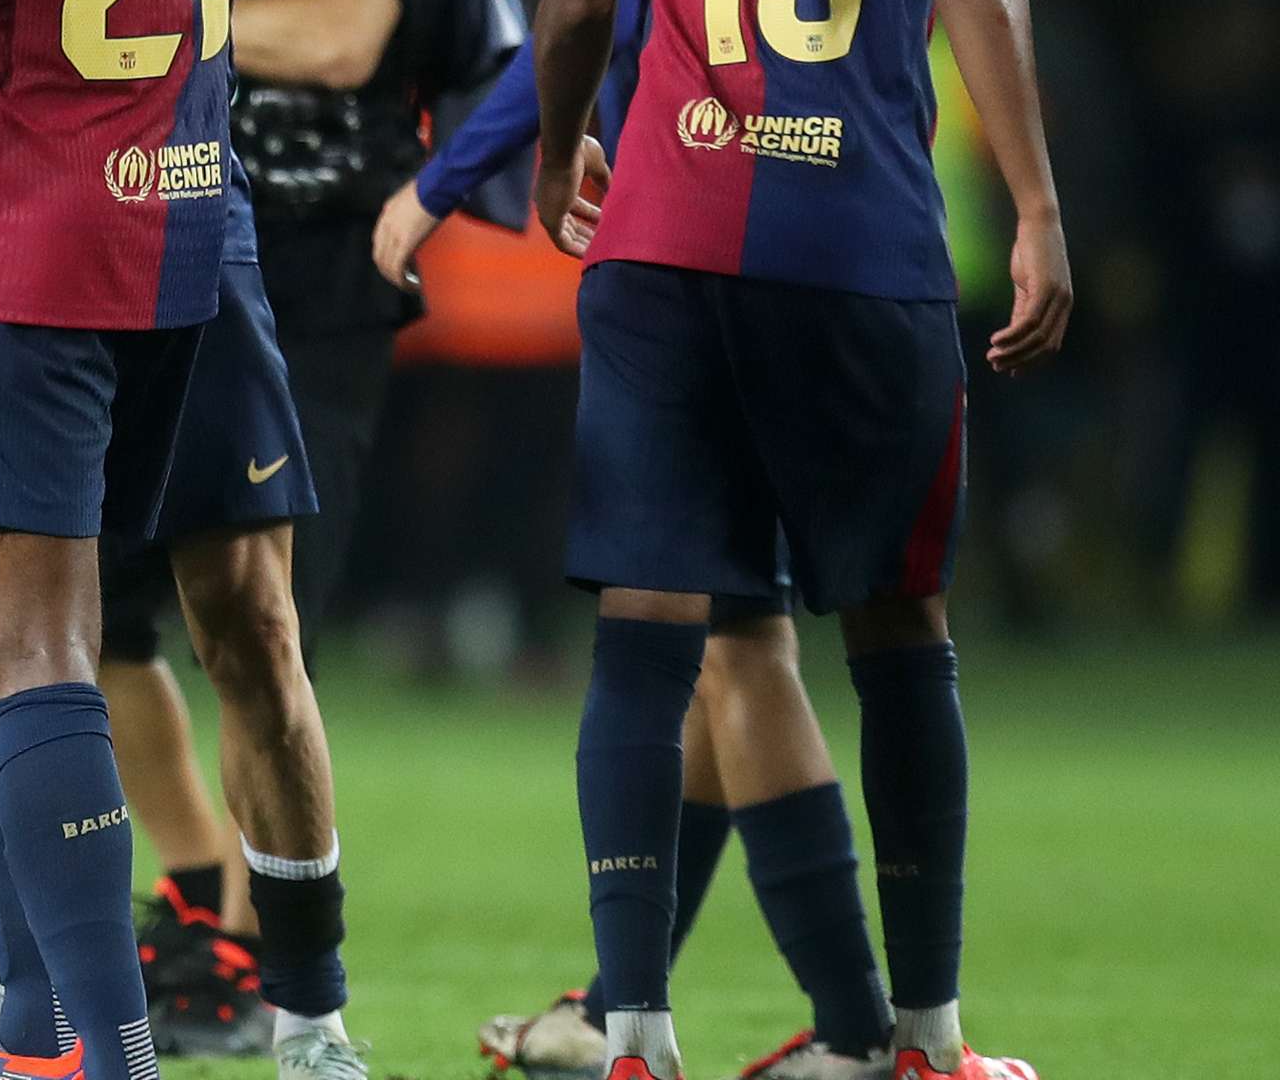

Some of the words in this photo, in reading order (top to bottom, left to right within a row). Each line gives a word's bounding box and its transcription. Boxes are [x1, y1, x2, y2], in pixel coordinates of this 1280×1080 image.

[744, 115, 843, 137] UNHCR
[157, 142, 220, 169] UNHCR
[741, 132, 840, 157] ACNUR
[157, 164, 221, 191] ACNUR
